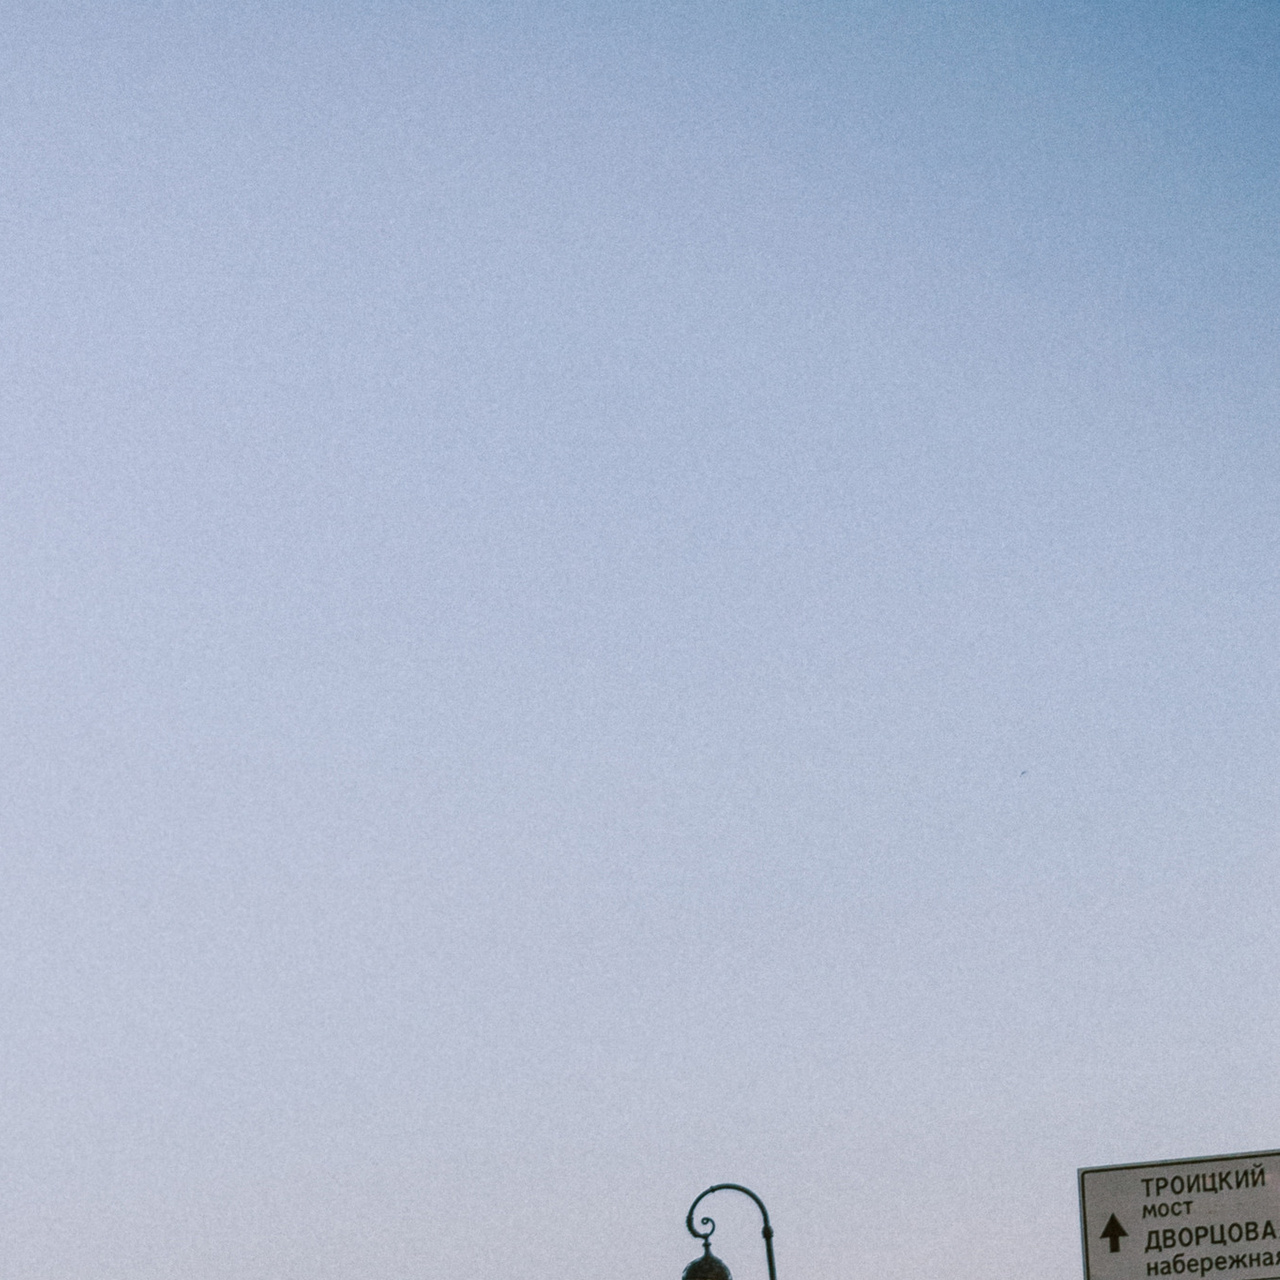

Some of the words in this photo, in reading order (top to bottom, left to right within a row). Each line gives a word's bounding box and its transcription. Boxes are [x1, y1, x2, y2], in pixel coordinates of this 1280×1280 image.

[1141, 1163, 1266, 1197] ТРОИЦКИЙ
[1142, 1201, 1193, 1219] мост
[1144, 1220, 1280, 1253] ДВОРЦОВА
